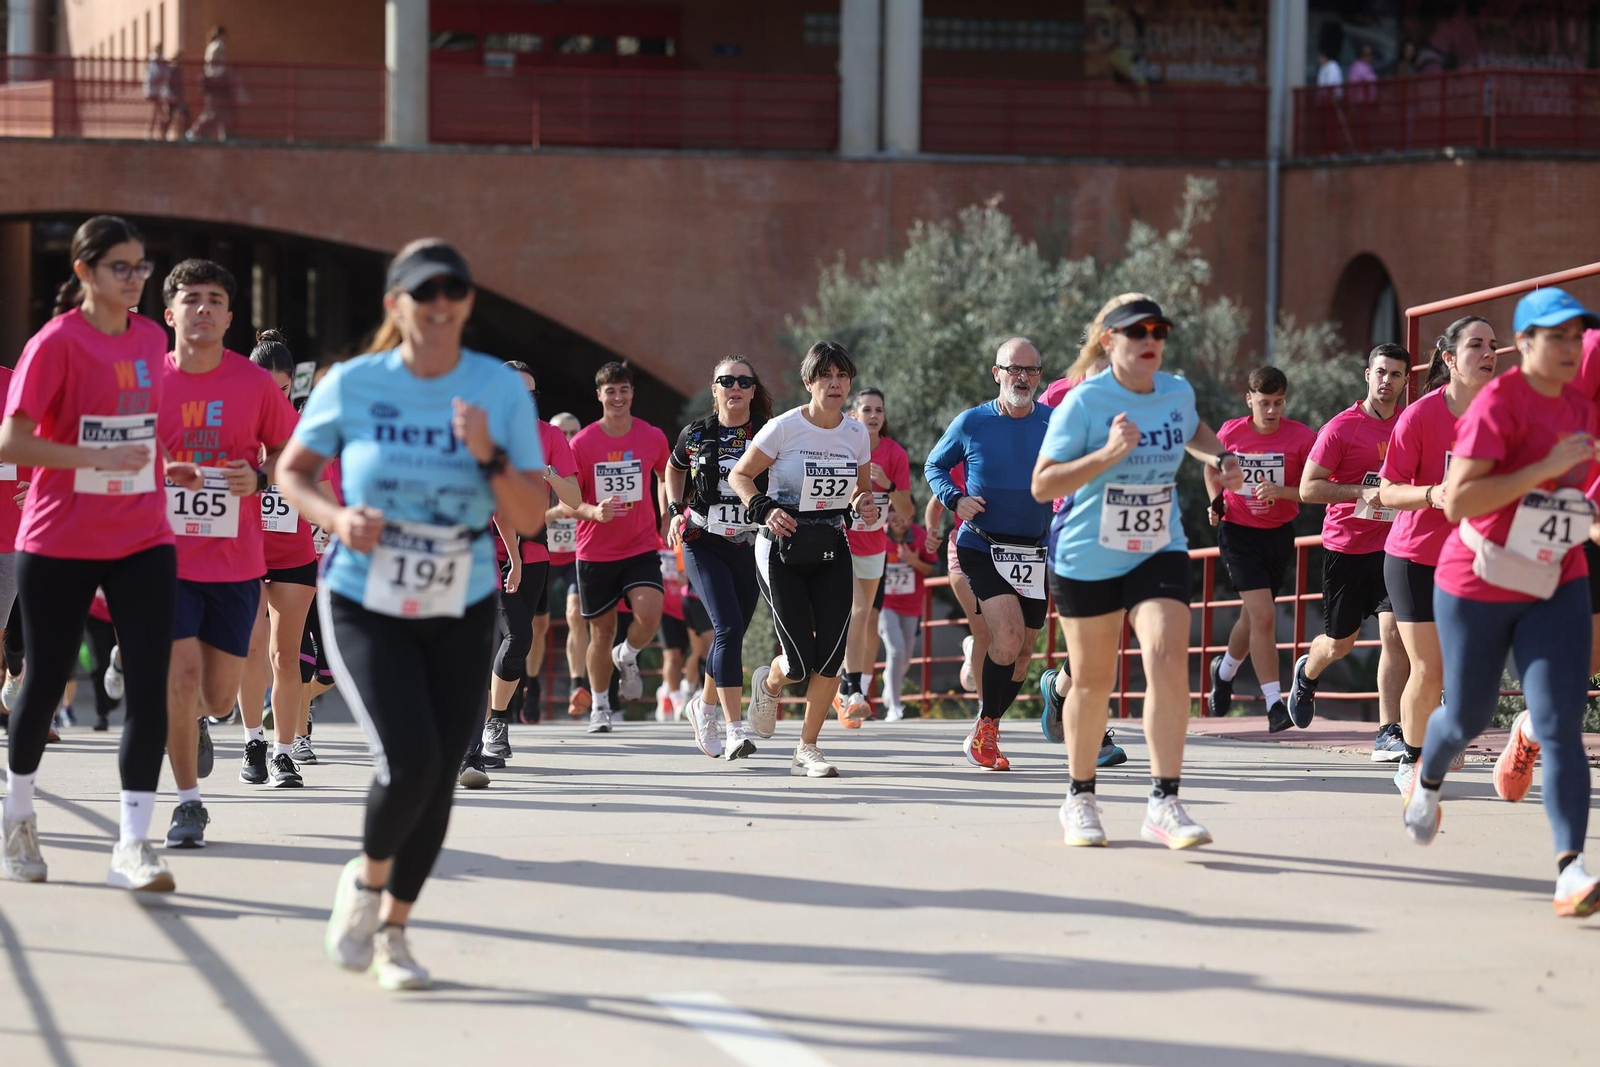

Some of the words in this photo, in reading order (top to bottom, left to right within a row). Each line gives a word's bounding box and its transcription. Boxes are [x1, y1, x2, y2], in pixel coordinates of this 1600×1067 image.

[115, 359, 152, 389] WE
[181, 400, 223, 428] WE
[85, 428, 123, 440] UMA
[374, 418, 460, 454] nerj
[1137, 423, 1183, 451] erja
[597, 468, 618, 476] UMA
[807, 468, 831, 476] UMA
[1243, 469, 1276, 484] 201
[604, 476, 635, 492] 335
[810, 479, 849, 497] 532
[1365, 478, 1381, 486] UM
[174, 491, 226, 517] 165
[187, 525, 199, 533] WE
[1116, 508, 1163, 533] 183
[1539, 514, 1572, 543] 41
[554, 531, 576, 543] 69
[994, 553, 1019, 561] UMA
[389, 556, 455, 592] 194
[1010, 564, 1033, 583] 42
